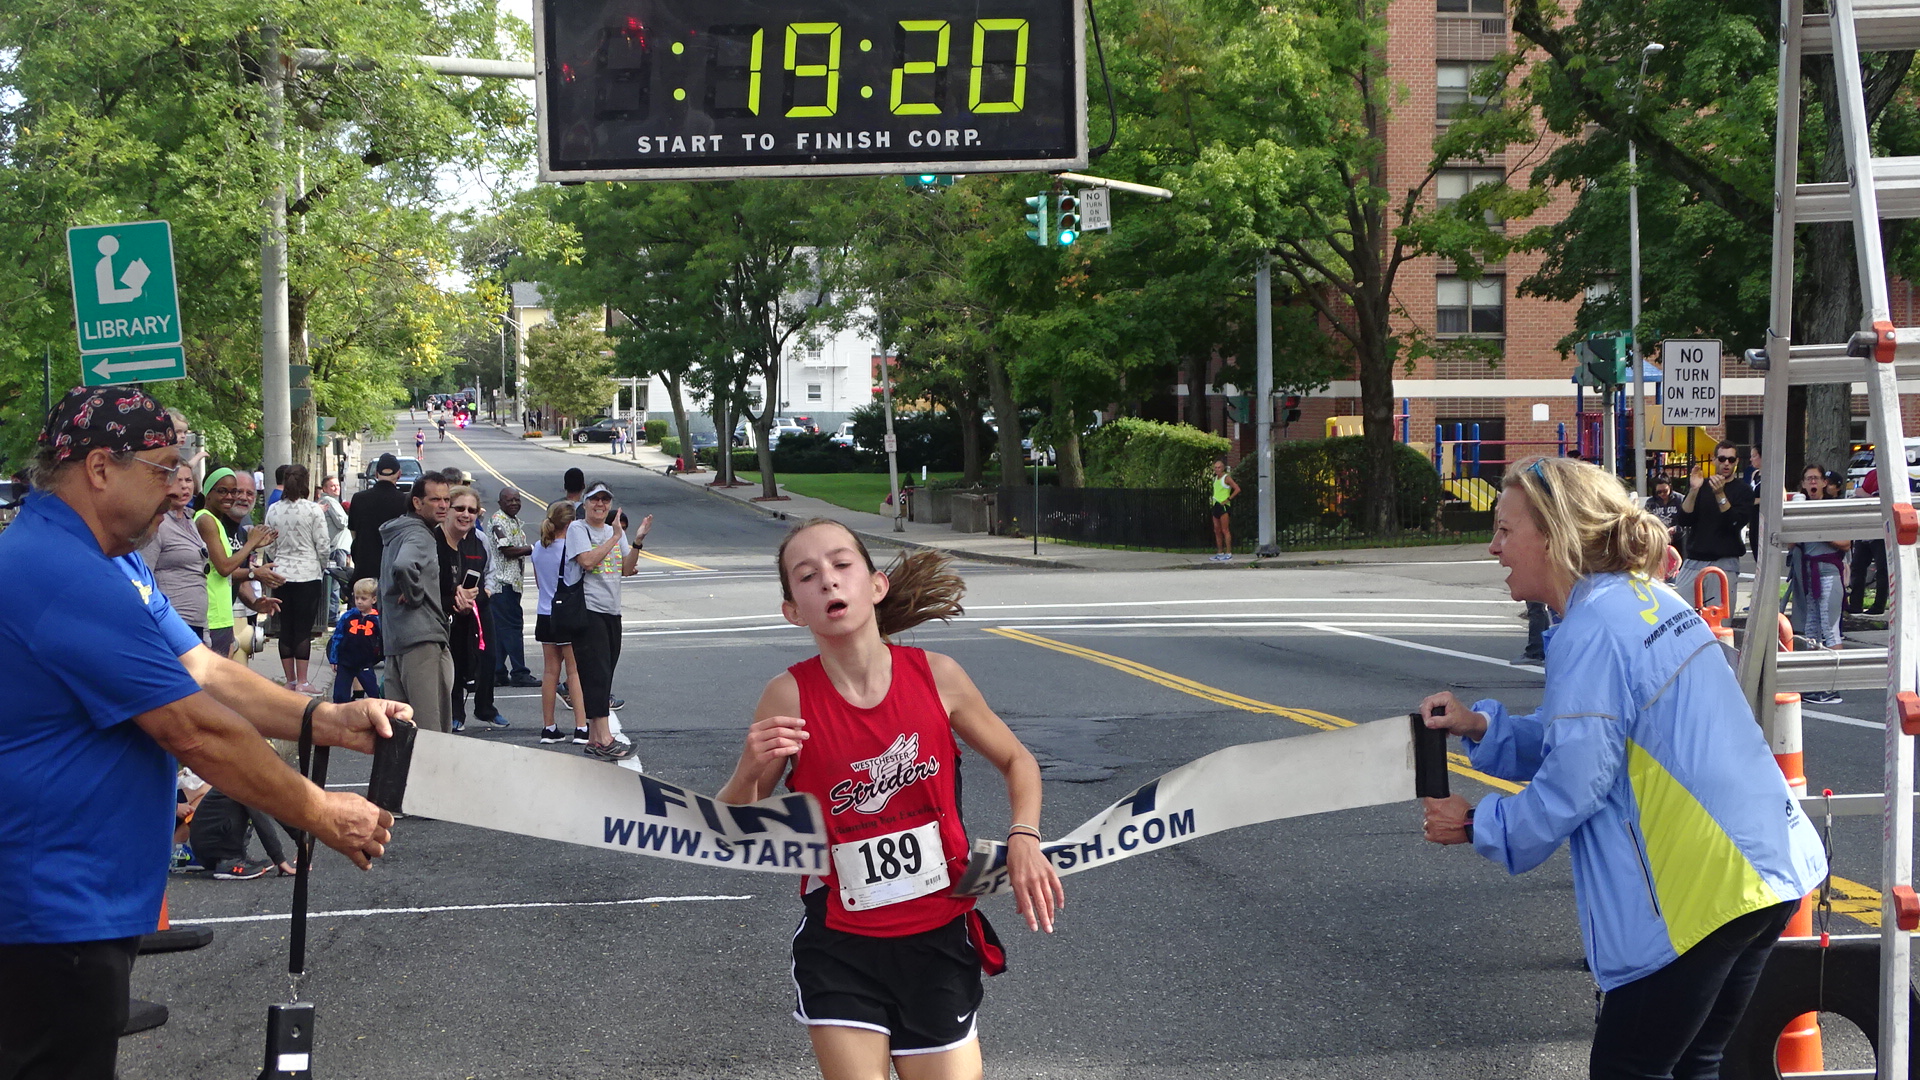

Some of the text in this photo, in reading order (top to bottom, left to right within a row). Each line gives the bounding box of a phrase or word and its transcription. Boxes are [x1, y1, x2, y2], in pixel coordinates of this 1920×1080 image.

[637, 128, 982, 153] START TO FINISH CORP.
[1086, 192, 1101, 200] NO
[84, 314, 171, 340] LIBRARY
[1681, 348, 1703, 363] NO
[1675, 368, 1709, 381] TURN
[1667, 386, 1716, 400] ON RED
[1667, 407, 1716, 418] 7AM-7PM
[852, 751, 911, 771] WESTCHESTER
[830, 756, 939, 815] Striders
[858, 832, 922, 885] 189
